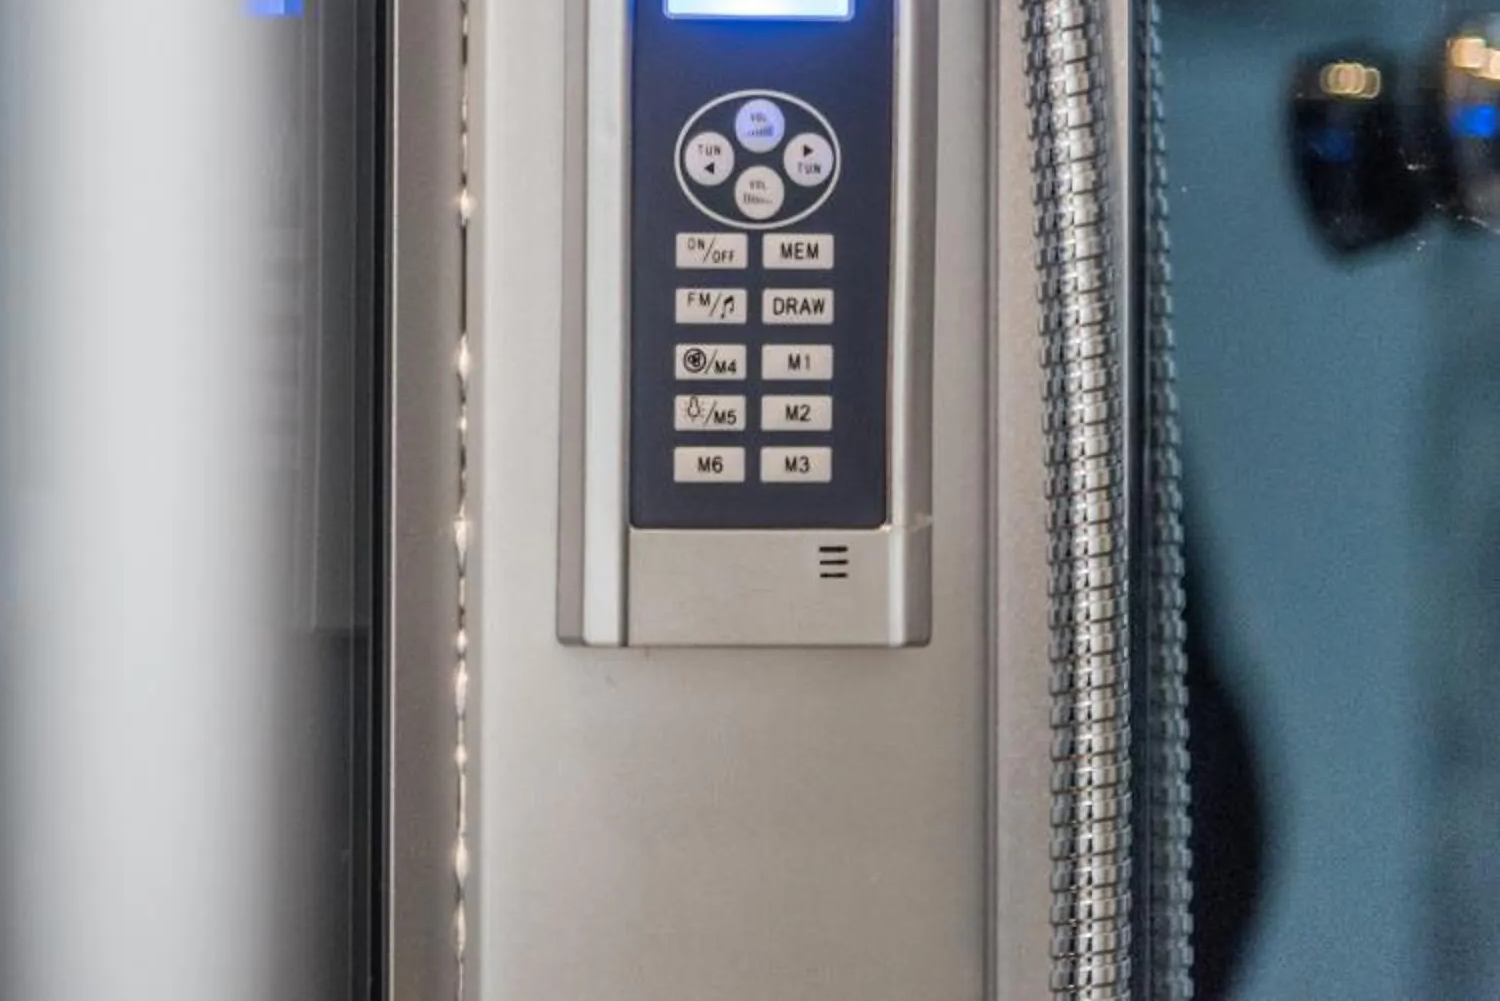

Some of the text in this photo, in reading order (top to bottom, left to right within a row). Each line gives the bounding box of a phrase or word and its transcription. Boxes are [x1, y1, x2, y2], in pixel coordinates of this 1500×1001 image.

[697, 144, 721, 156] TUN
[797, 162, 821, 174] TUN
[780, 242, 819, 260] MEM
[772, 297, 826, 316] DRAW
[787, 353, 811, 371] M1
[785, 404, 811, 422] M2
[697, 456, 724, 474] M6
[784, 455, 810, 474] M3
